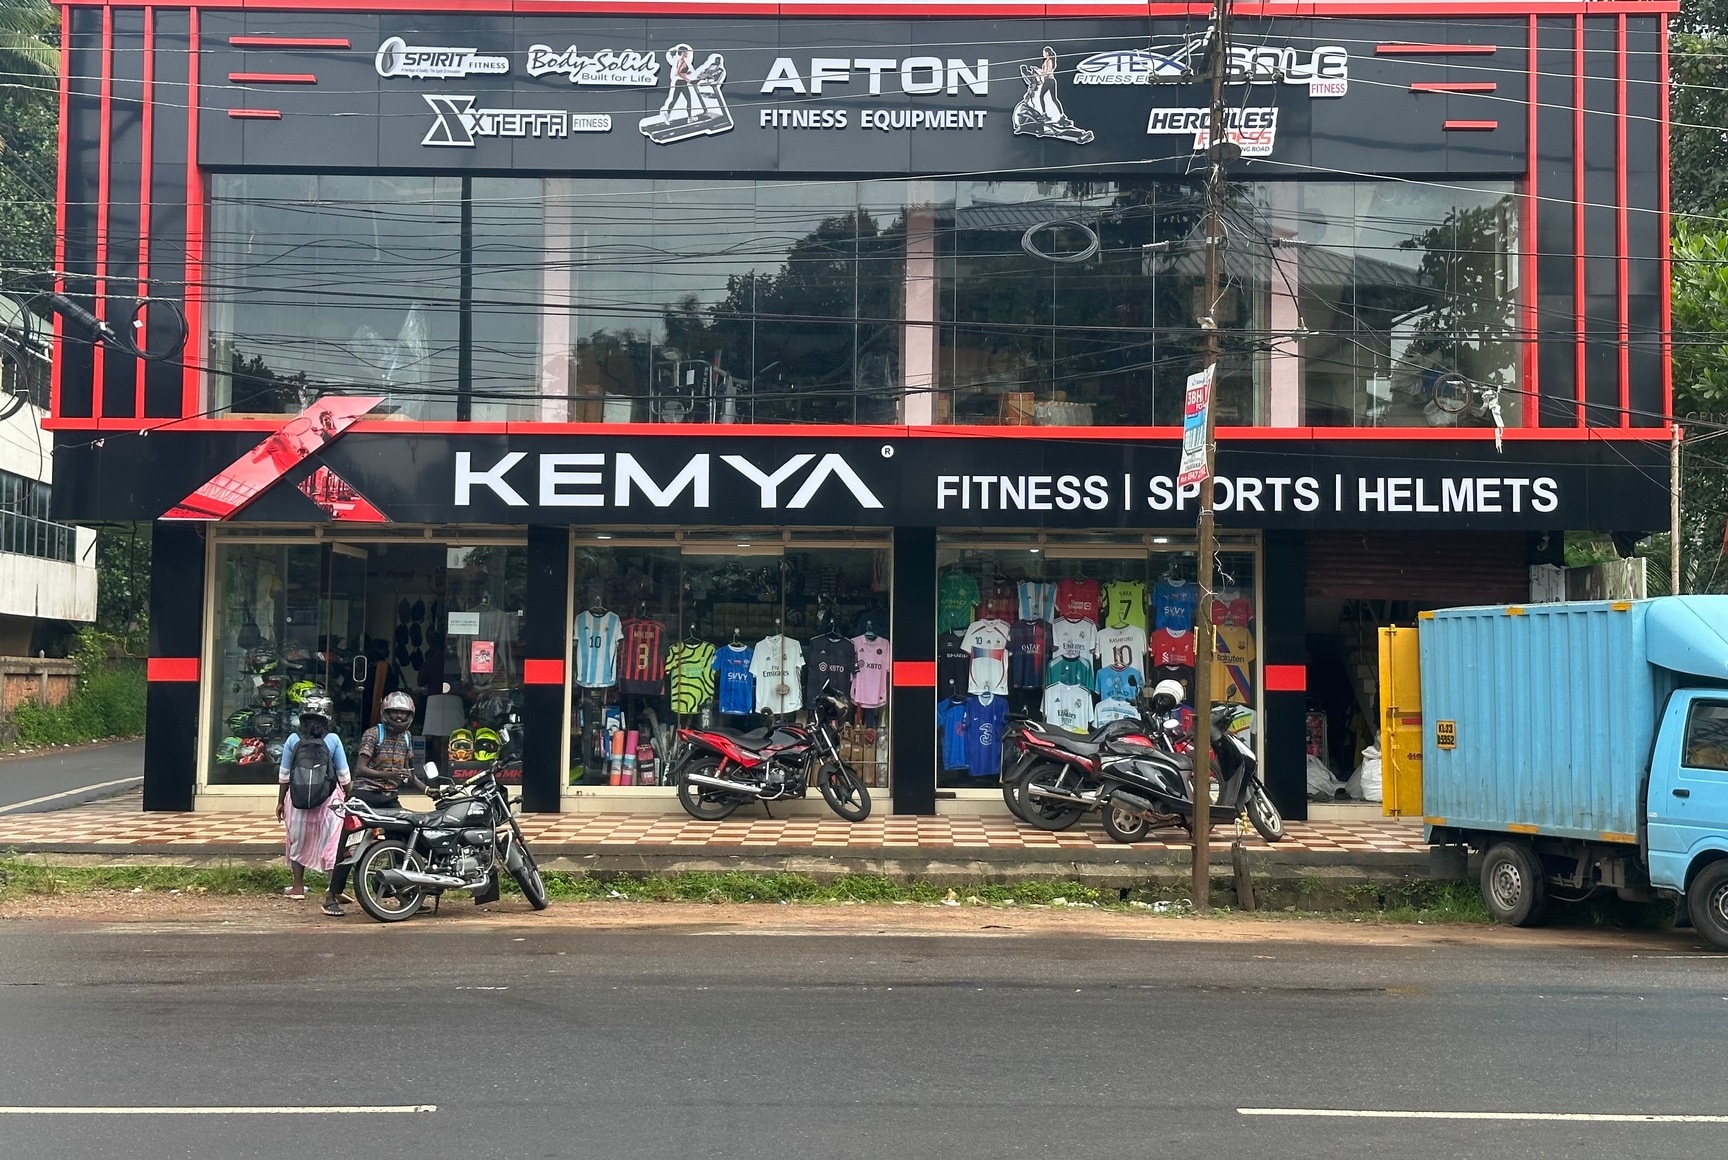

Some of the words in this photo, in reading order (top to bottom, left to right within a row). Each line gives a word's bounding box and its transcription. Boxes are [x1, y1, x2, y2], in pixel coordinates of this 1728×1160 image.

[403, 53, 467, 67] SPIRIT
[532, 49, 655, 77] Body-Solid
[581, 73, 607, 81] Built
[611, 74, 627, 82] for
[760, 57, 988, 95] AFTON
[1075, 75, 1135, 83] FITNESS
[1311, 83, 1345, 94] FITNESS
[574, 118, 608, 128] FITNESS
[760, 109, 848, 128] FITNESS
[861, 110, 988, 131] EQUIPMENT
[454, 451, 884, 509] KEMYA
[936, 475, 1109, 511] FITNESS
[1147, 475, 1320, 513] SPORTS
[1358, 476, 1559, 513] HELMETS
[1120, 600, 1132, 620] 7
[589, 636, 602, 648] 10
[975, 636, 983, 645] 10
[638, 643, 649, 670] 3
[1112, 644, 1133, 667] 10
[865, 662, 883, 670] XBTO
